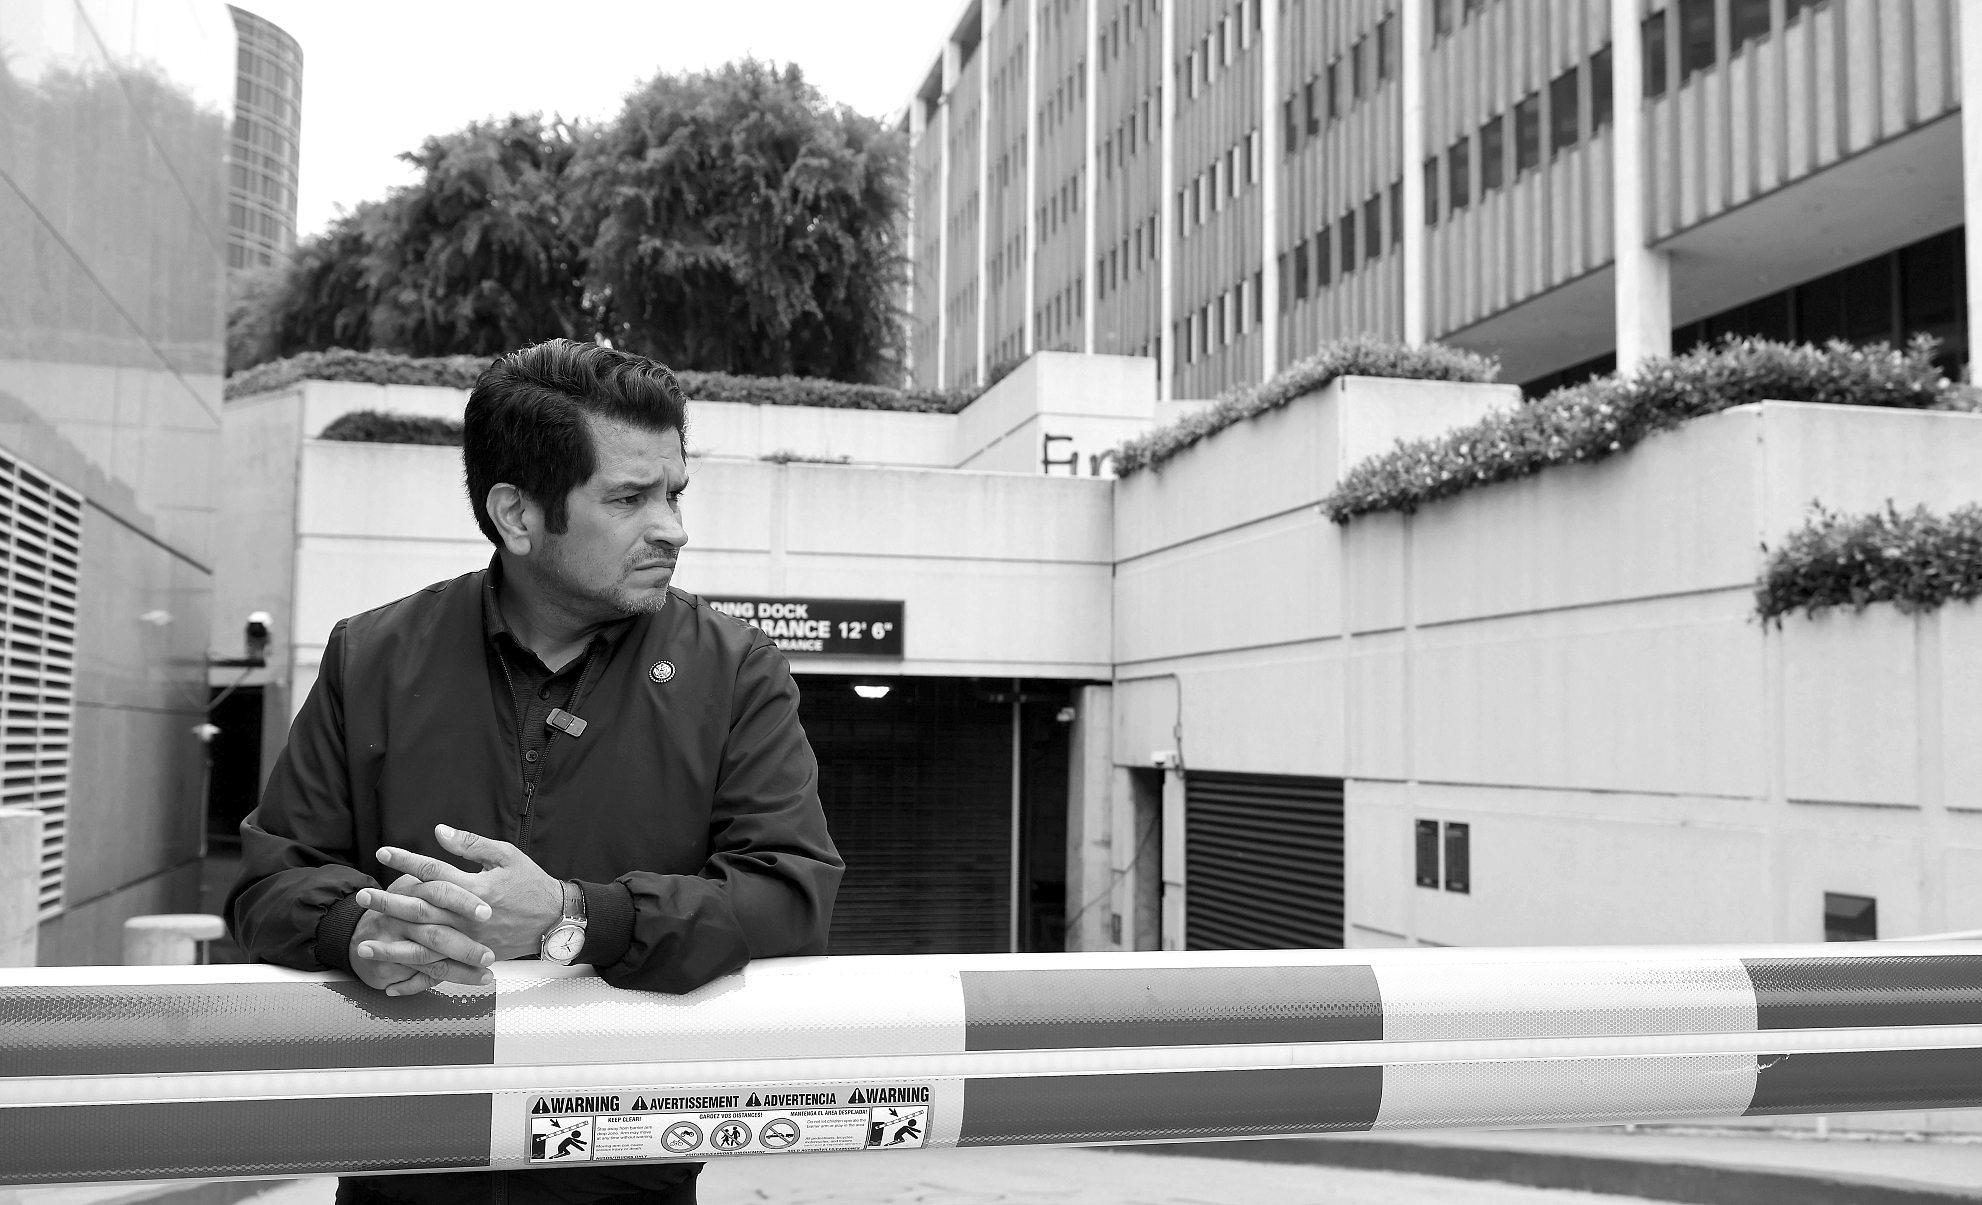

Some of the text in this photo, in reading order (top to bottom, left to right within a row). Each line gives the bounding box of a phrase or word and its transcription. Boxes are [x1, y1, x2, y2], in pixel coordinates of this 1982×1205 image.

[709, 601, 808, 619] DING DOCK
[838, 621, 867, 640] 12'
[871, 621, 894, 640] 6"
[551, 1086, 930, 1113] WARNING AVERTISSEMENT ADVERTENCIA WARNING
